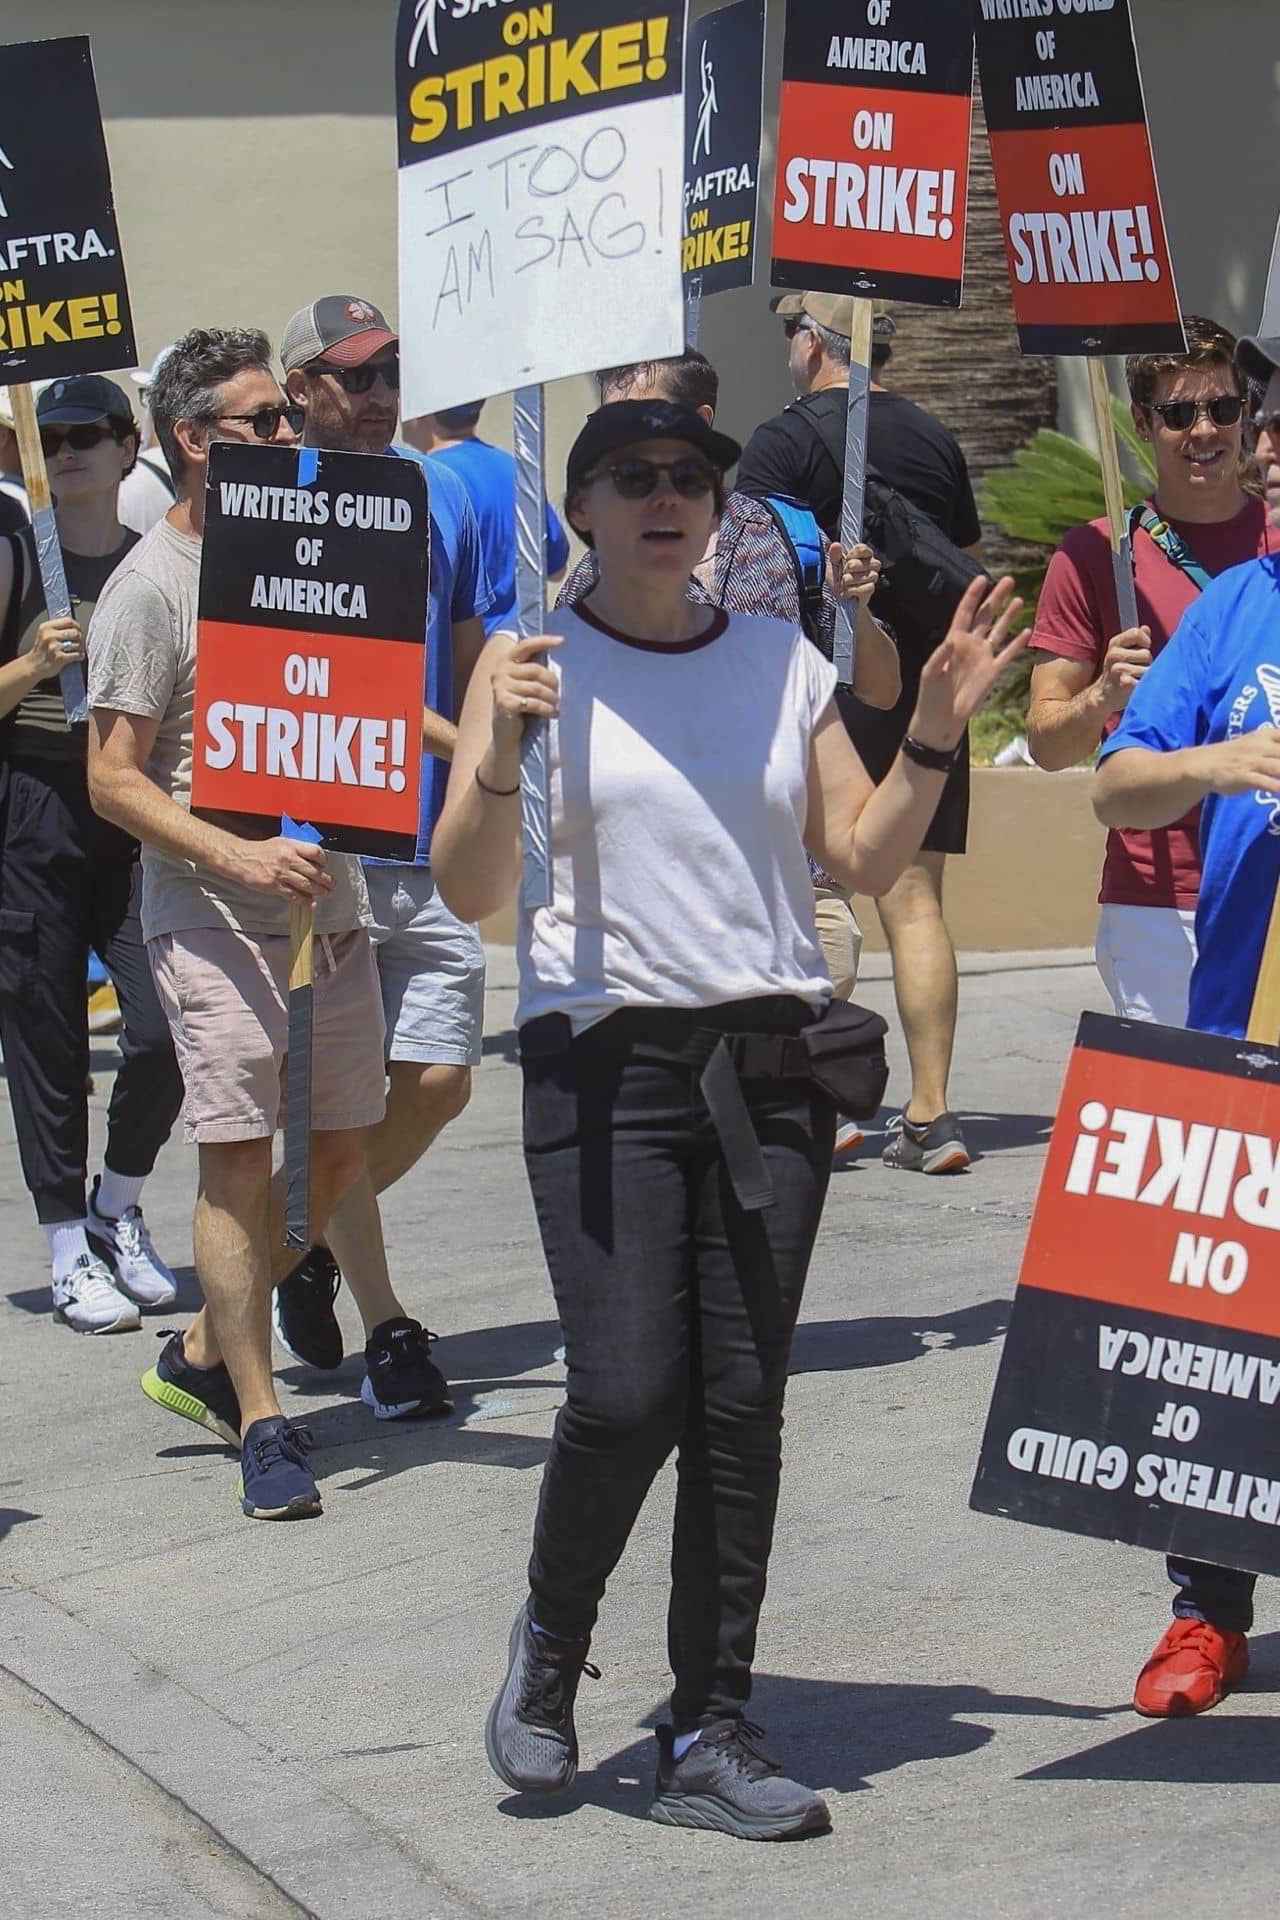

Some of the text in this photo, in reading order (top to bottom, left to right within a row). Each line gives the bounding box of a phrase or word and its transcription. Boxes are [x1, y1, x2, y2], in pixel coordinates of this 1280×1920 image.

[503, 4, 553, 46] ON
[867, 0, 891, 26] OF
[826, 36, 927, 75] AMERICA
[1035, 31, 1056, 60] OF
[409, 16, 669, 143] STRIKE!
[1016, 71, 1100, 112] AMERICA
[852, 110, 894, 151] ON
[425, 127, 627, 236] I TOO
[1049, 153, 1085, 197] ON
[690, 208, 708, 231] ON
[784, 157, 956, 240] STRIKE!
[433, 168, 663, 330] AM SAG!
[681, 220, 751, 273] RIKE!
[1008, 205, 1160, 285] STRIKE!
[0, 280, 25, 302] N
[219, 482, 413, 532] WRITERS GUILD
[295, 537, 324, 567] OF
[250, 575, 368, 619] AMERICA
[284, 654, 330, 698] ON
[205, 700, 407, 793] STRIKE!
[1168, 1232, 1249, 1295] ON
[1098, 1325, 1280, 1404] AMERICA
[1152, 1402, 1200, 1443] OF
[1006, 1427, 1280, 1526] RITERS GUILD
